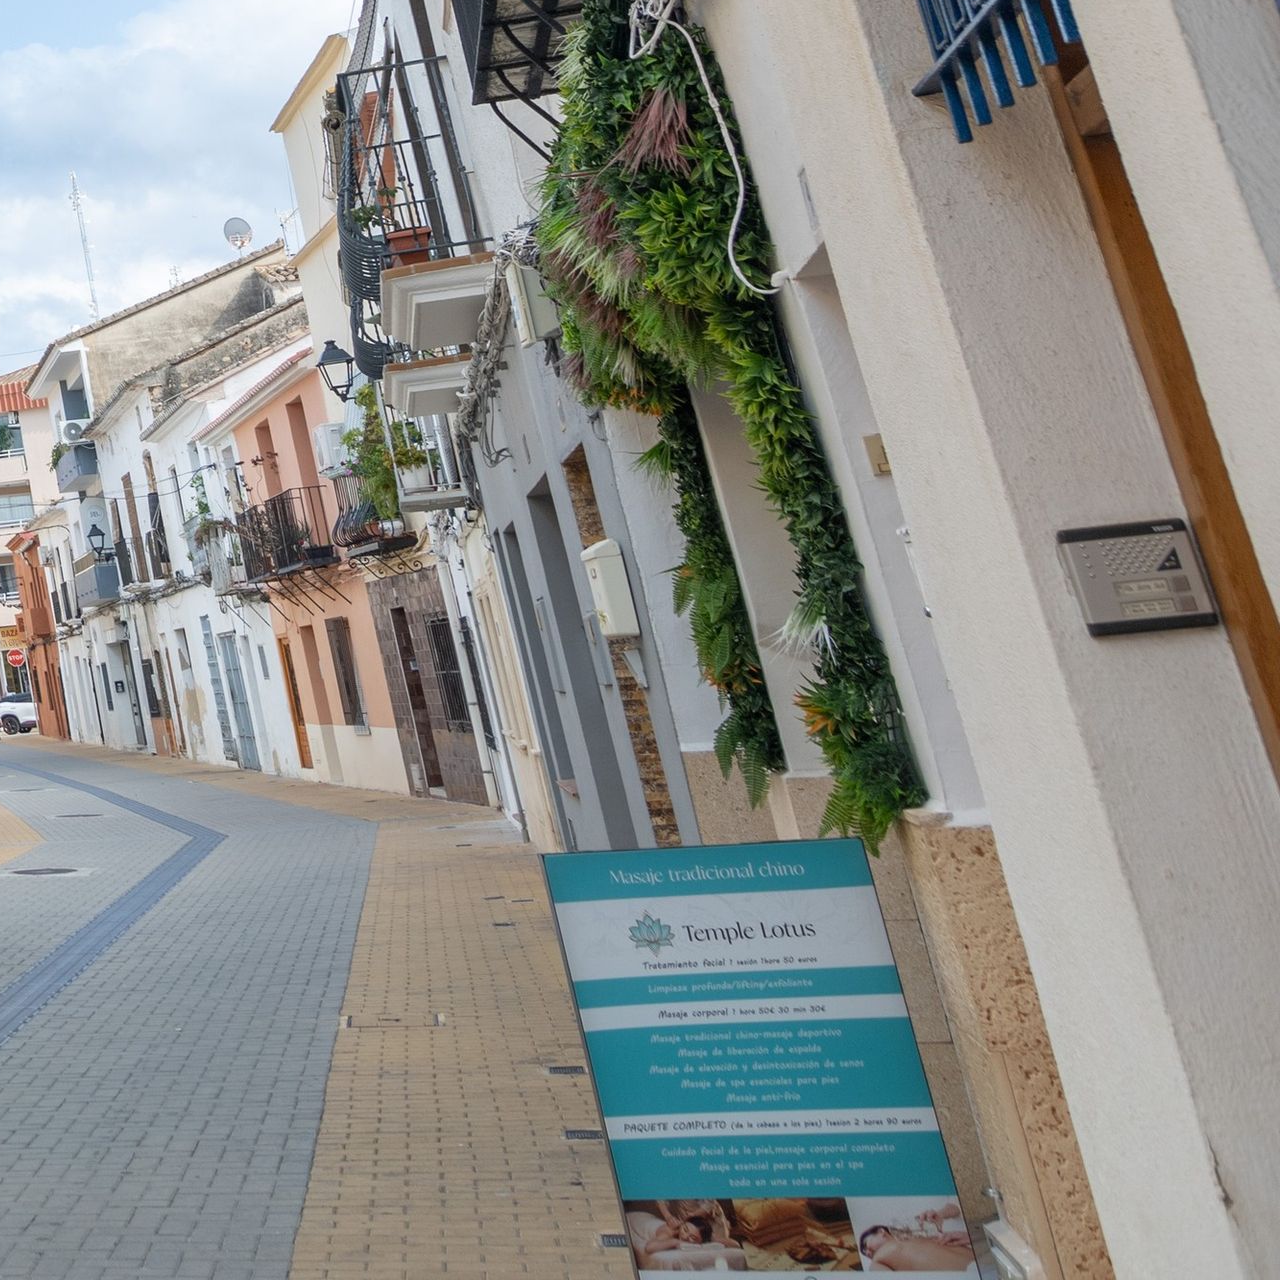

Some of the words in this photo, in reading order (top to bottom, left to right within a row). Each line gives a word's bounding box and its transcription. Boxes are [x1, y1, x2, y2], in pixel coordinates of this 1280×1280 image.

[609, 870, 663, 886] Masaje
[668, 862, 754, 882] tradicional
[758, 860, 805, 878] chino
[682, 922, 754, 945] Temple
[760, 920, 816, 939] Lotus
[642, 960, 698, 970] Tratamiento
[702, 958, 726, 968] facial
[658, 1008, 688, 1020] Masaje
[692, 1008, 728, 1019] corporal
[650, 1034, 680, 1044] Masaje
[685, 1032, 732, 1042] tradicional
[678, 1048, 708, 1058] Masaje
[712, 1047, 723, 1056] de
[774, 1044, 784, 1054] de
[650, 1065, 680, 1076] Masaje
[684, 1064, 694, 1074] de
[824, 1059, 835, 1068] de
[681, 1079, 711, 1090] Masaje
[715, 1078, 726, 1088] de
[726, 1094, 758, 1104] Masaje
[624, 1122, 669, 1134] PAQUETE
[673, 1120, 727, 1131] COMPLETO
[886, 1117, 898, 1125] 90
[810, 1144, 848, 1154] corporal
[851, 1142, 896, 1154] completo
[700, 1162, 731, 1173] Masaje
